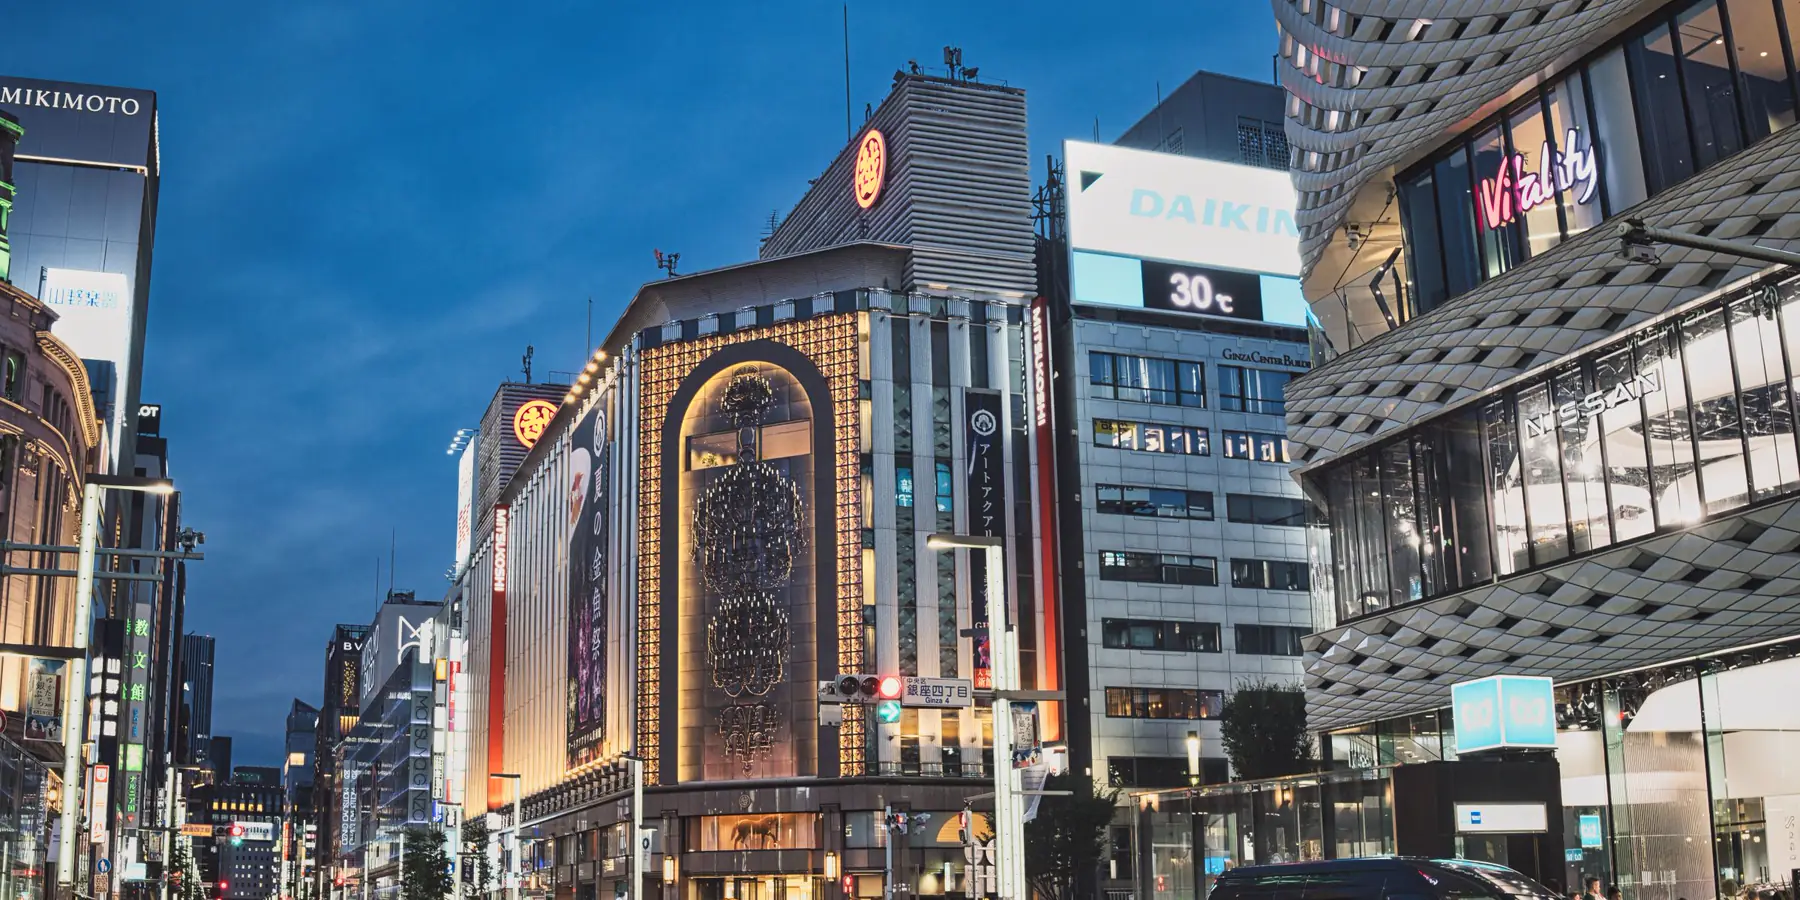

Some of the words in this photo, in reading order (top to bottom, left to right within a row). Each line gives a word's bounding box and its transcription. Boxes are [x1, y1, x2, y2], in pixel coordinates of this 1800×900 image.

[1, 86, 140, 116] MIKIMOTO
[1481, 127, 1598, 231] Vitality
[1032, 306, 1046, 427] MITSUKOSHI
[138, 406, 159, 417] OT
[1524, 368, 1662, 440] NISSAN
[494, 508, 507, 592] MITSUKOSHI
[131, 618, 149, 701] 教文館
[906, 677, 926, 685] 中央区
[906, 684, 968, 698] 銀座四丁目
[127, 775, 138, 813] ナルニア国
